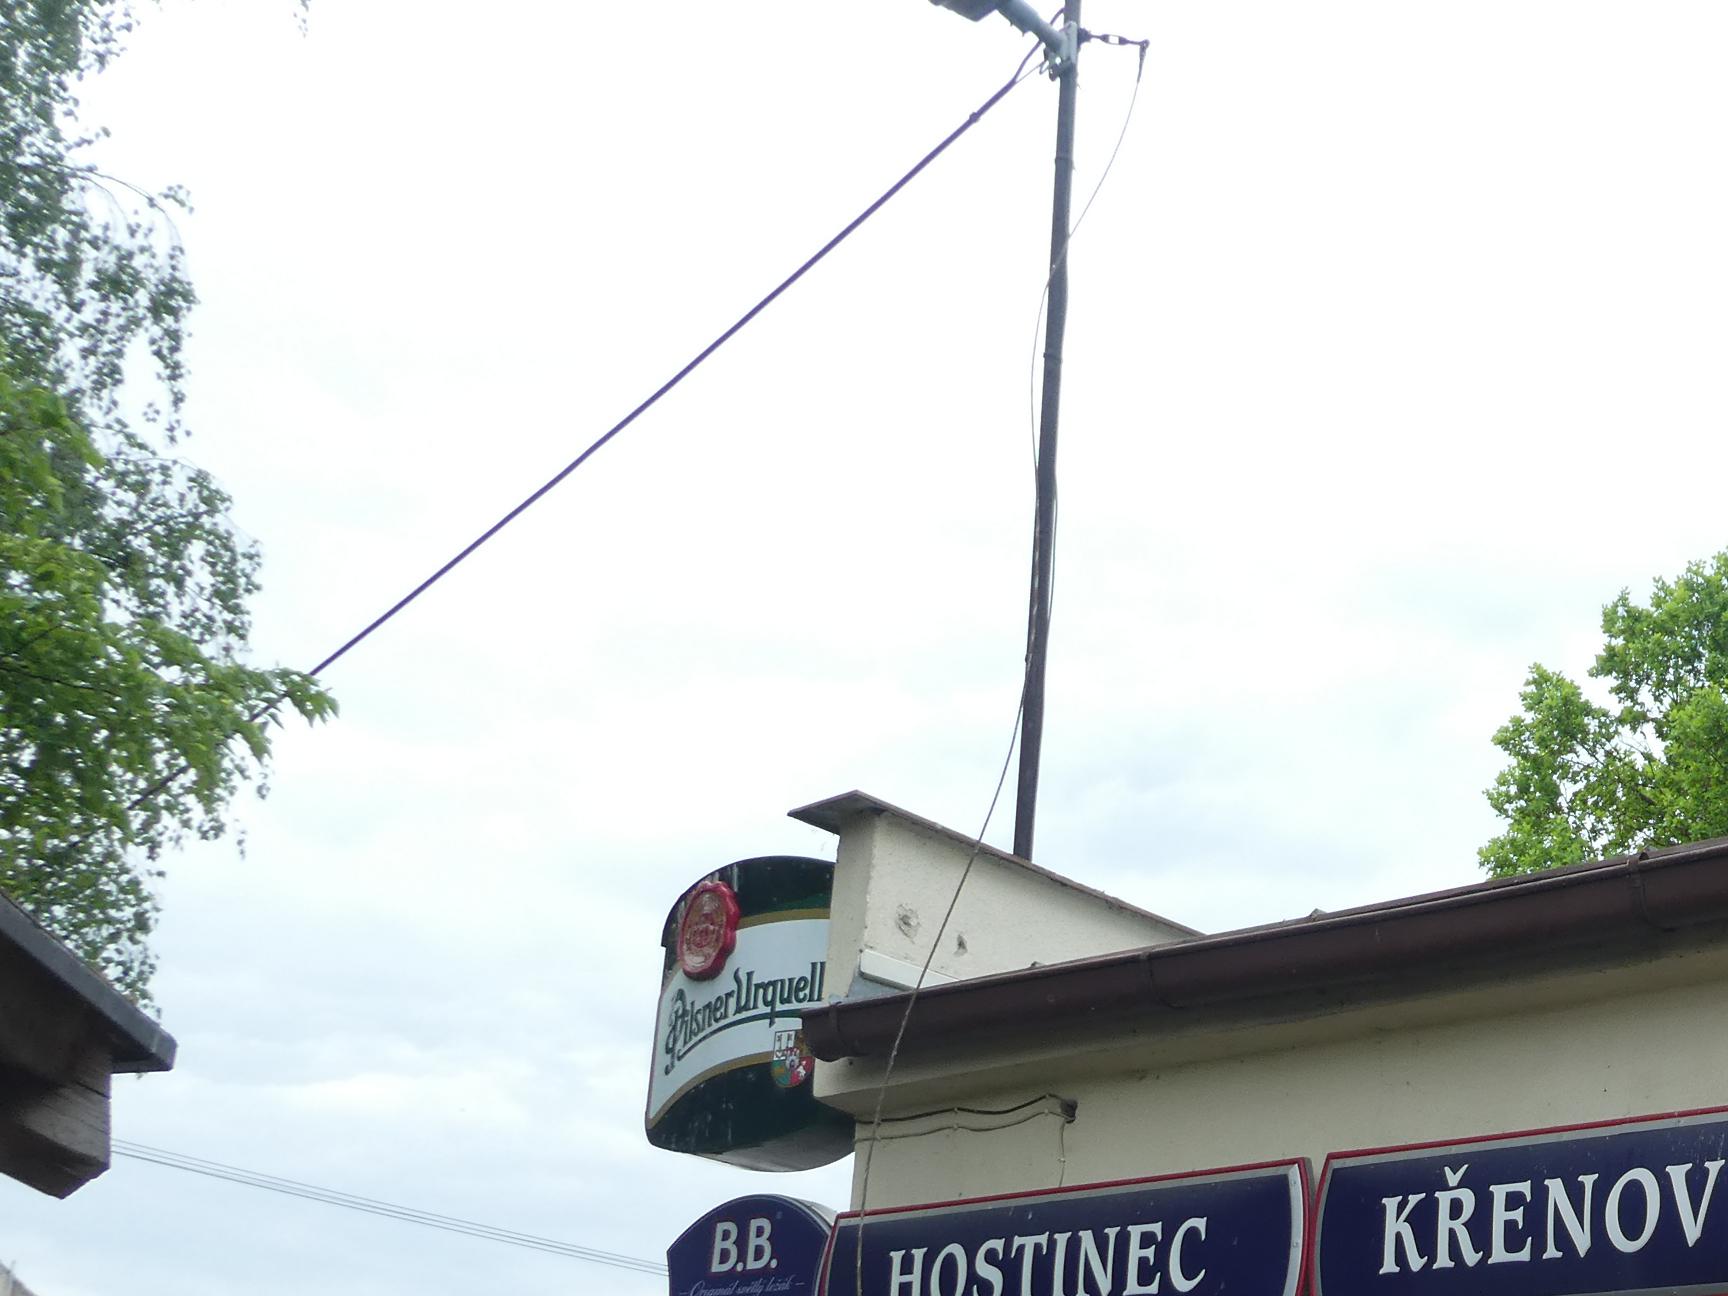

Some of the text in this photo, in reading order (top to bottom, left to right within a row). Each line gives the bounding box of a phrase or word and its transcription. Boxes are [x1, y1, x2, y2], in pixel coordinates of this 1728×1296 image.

[664, 961, 827, 1076] Pilsner Urquell
[711, 1217, 778, 1274] B.B.
